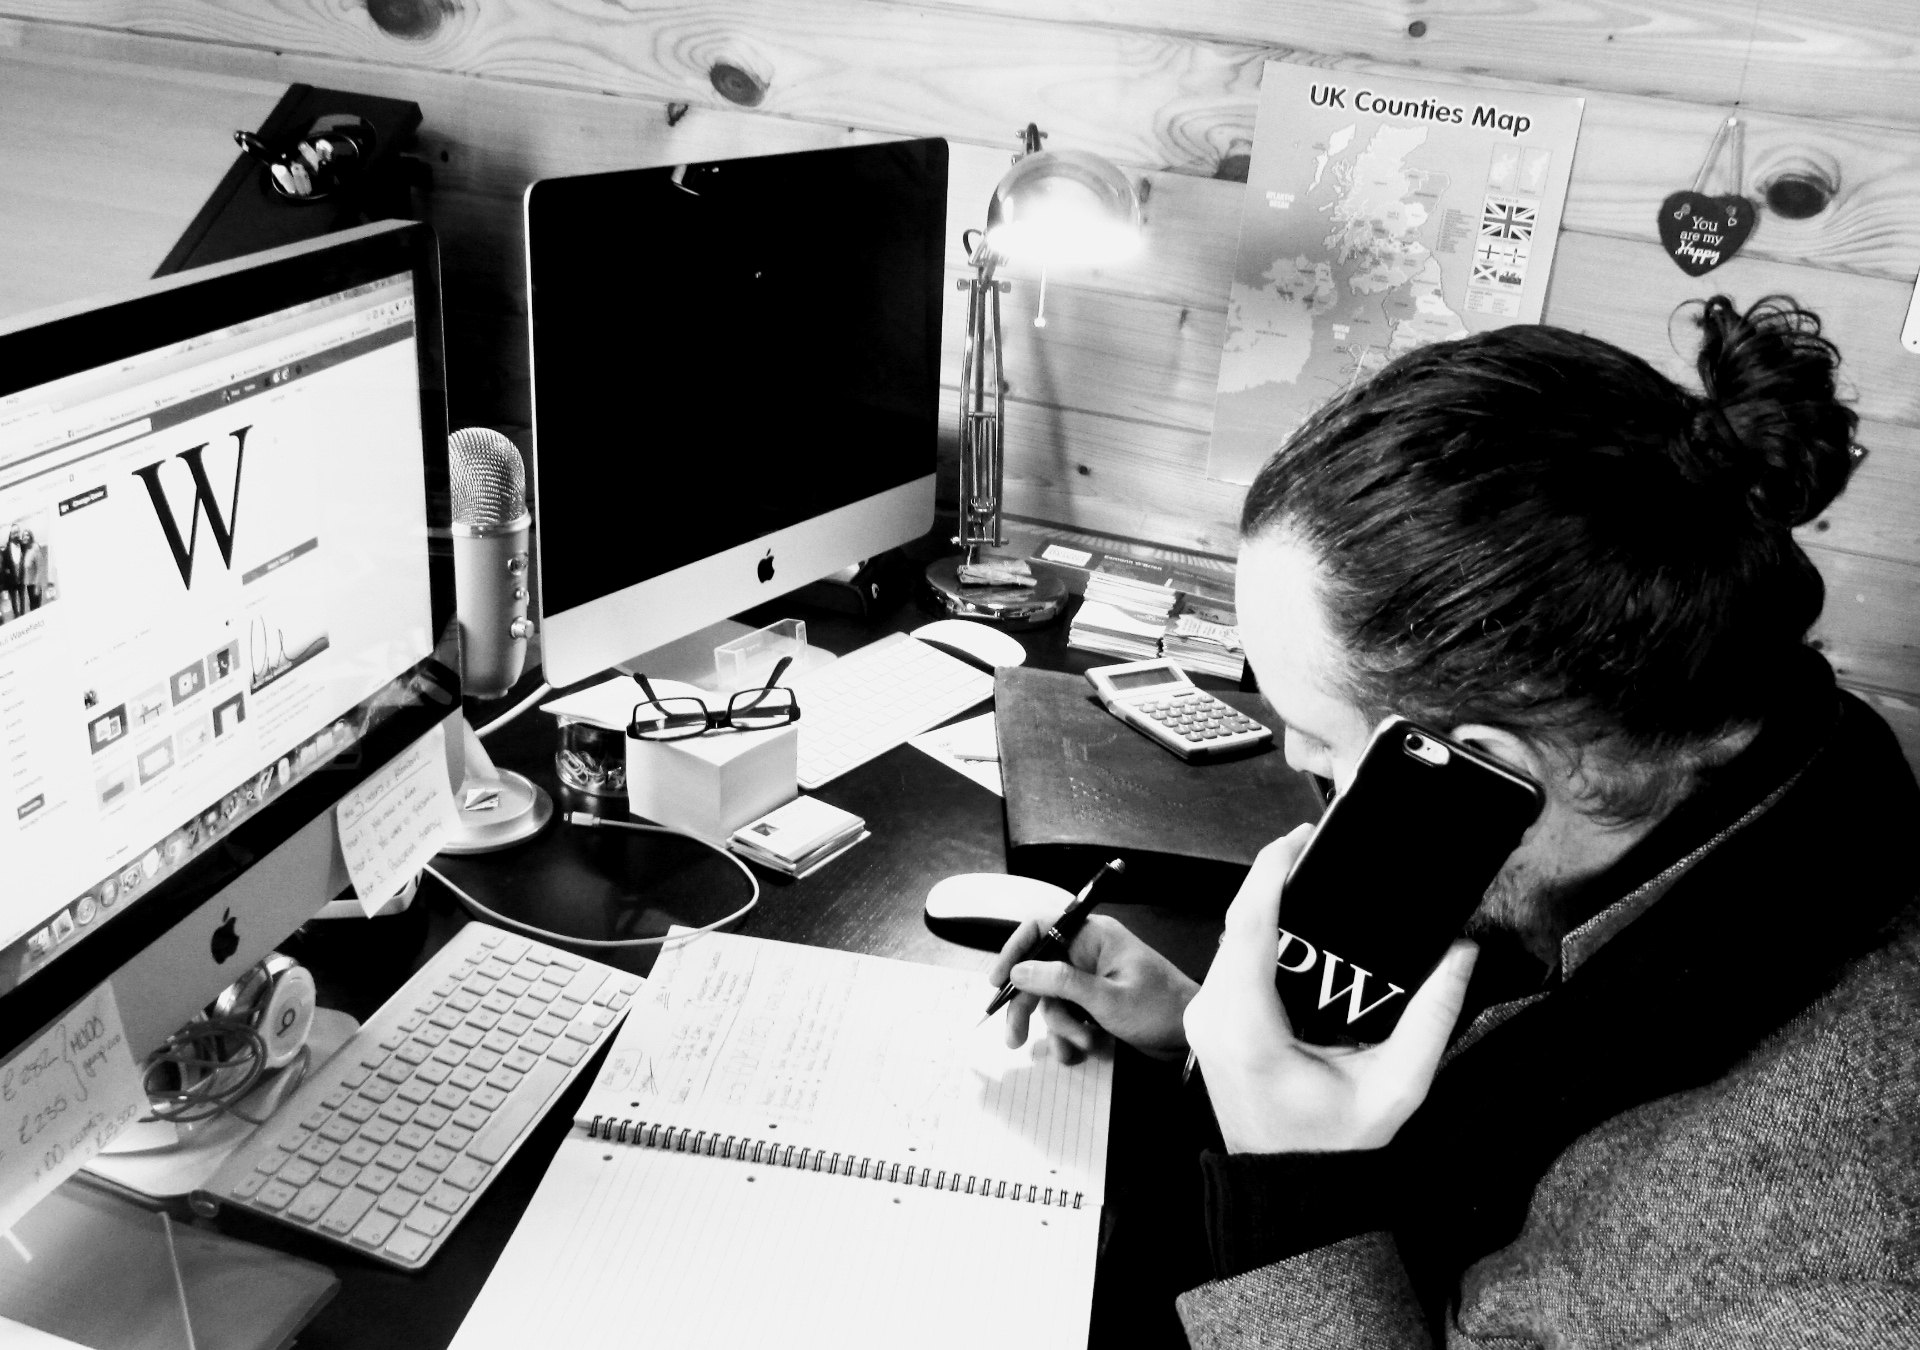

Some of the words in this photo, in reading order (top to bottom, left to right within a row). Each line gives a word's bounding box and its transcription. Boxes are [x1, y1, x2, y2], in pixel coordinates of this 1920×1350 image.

[1310, 85, 1346, 109] UK
[1354, 91, 1464, 124] Counties
[1471, 106, 1531, 138] Map
[1692, 215, 1719, 232] You
[1680, 230, 1701, 241] are
[1703, 233, 1724, 247] my
[1674, 240, 1721, 266] Happy
[131, 424, 254, 591] W
